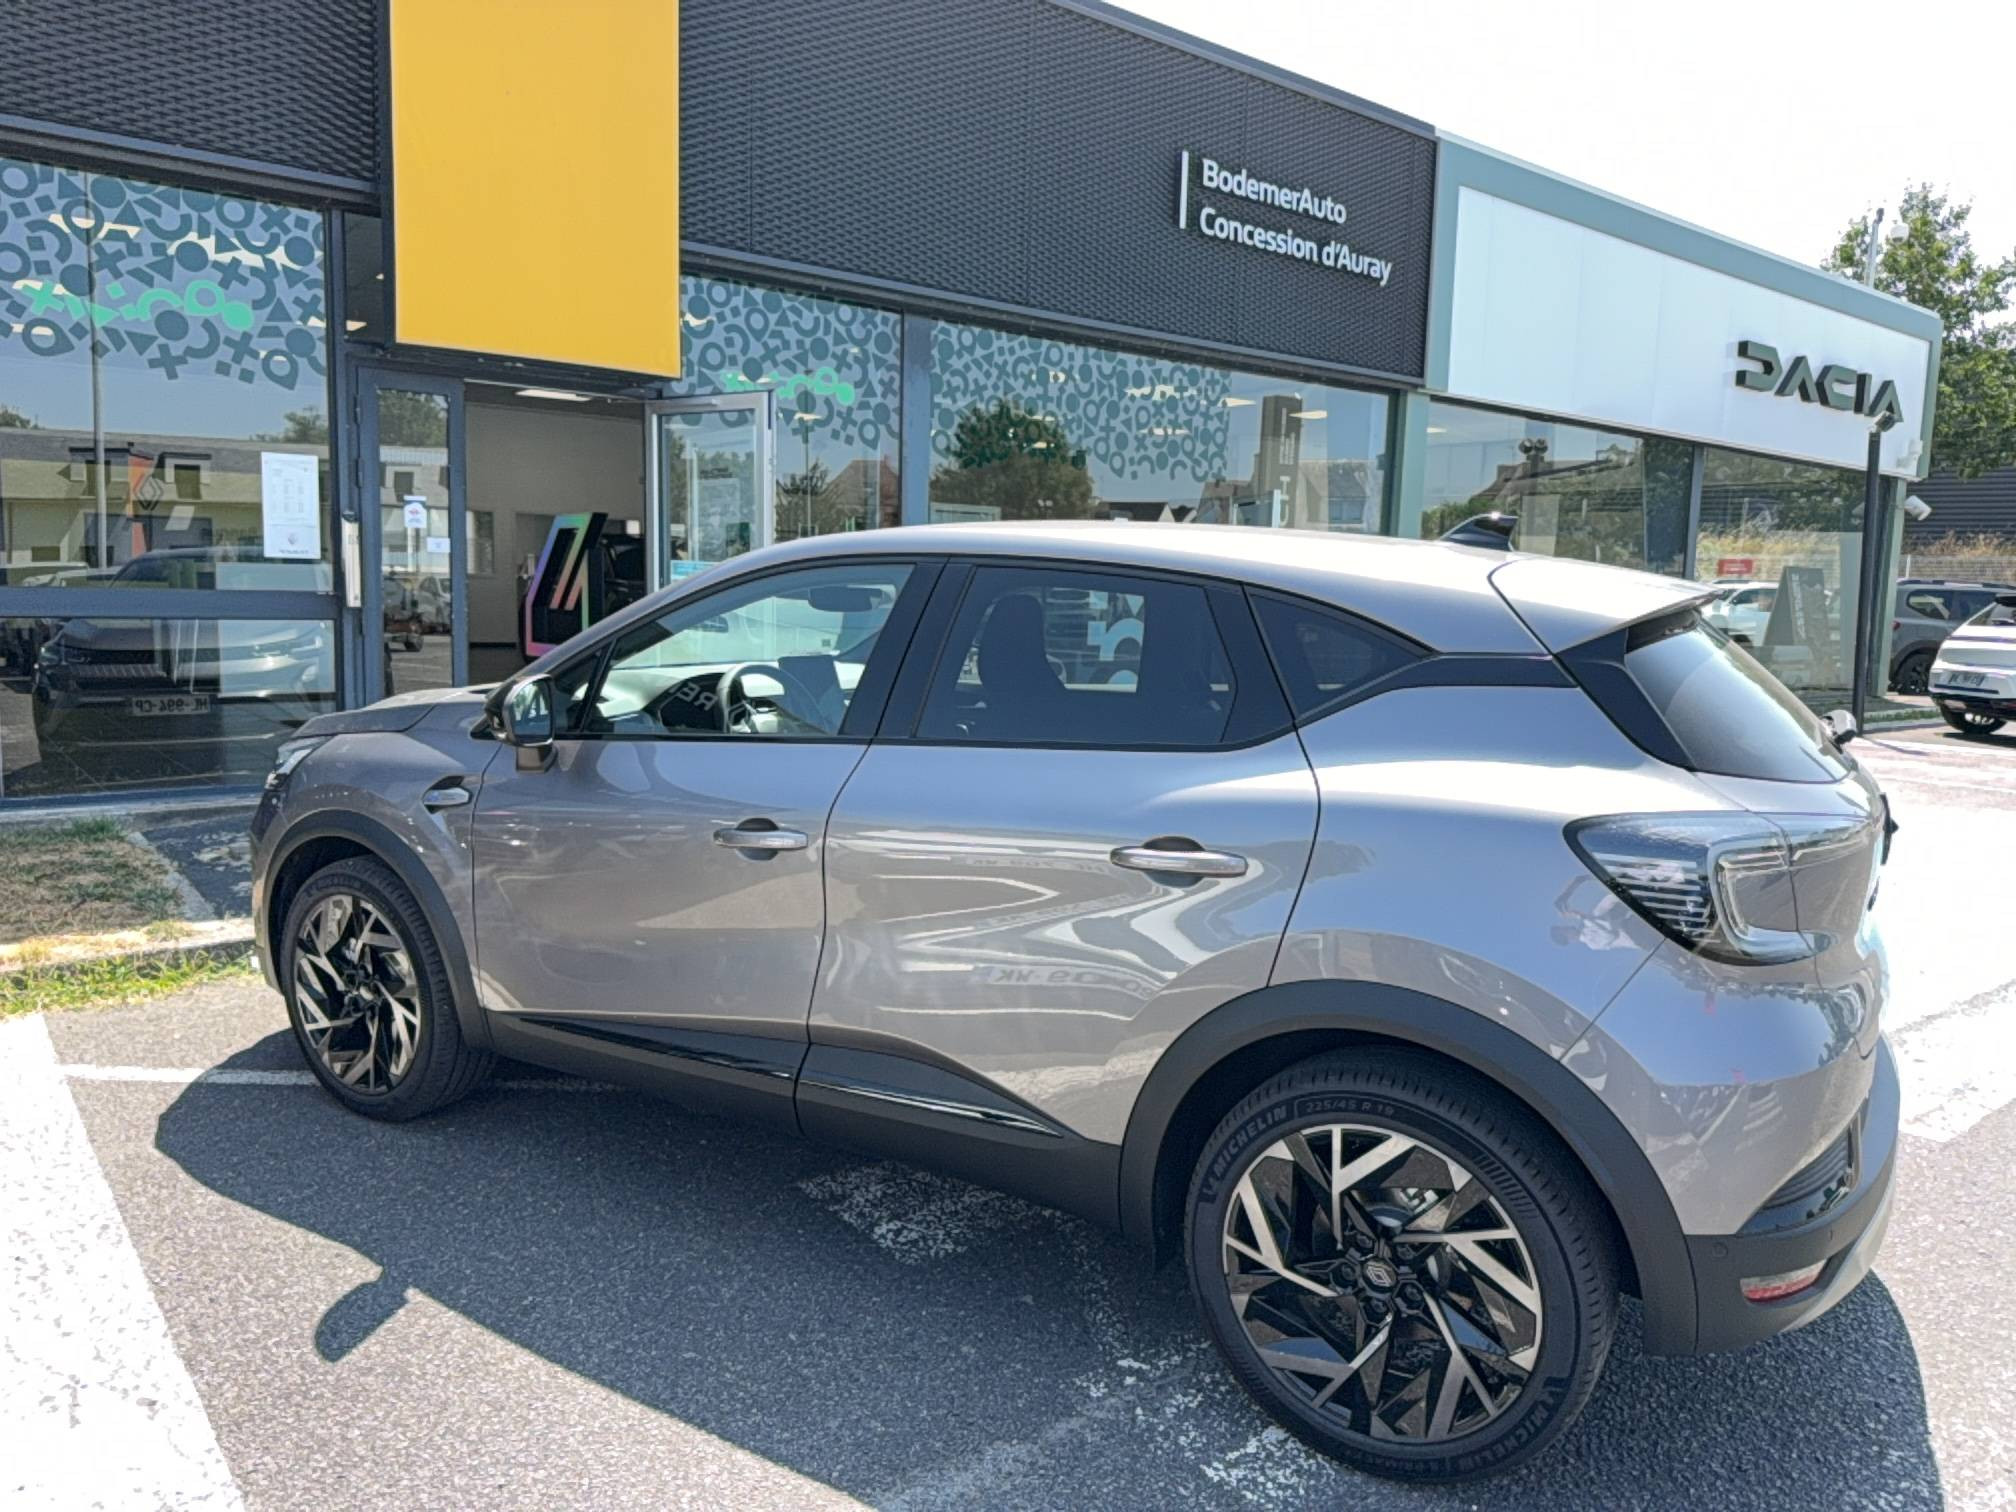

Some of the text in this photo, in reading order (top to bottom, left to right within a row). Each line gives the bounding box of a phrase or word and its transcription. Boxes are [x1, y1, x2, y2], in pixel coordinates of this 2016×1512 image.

[1202, 158, 1347, 224] BodemerAuto
[1200, 207, 1393, 287] Concession d'Auray
[1735, 340, 1904, 423] DACIA
[1214, 1105, 1288, 1177] MICHELIN
[1306, 1100, 1357, 1113] 225/45
